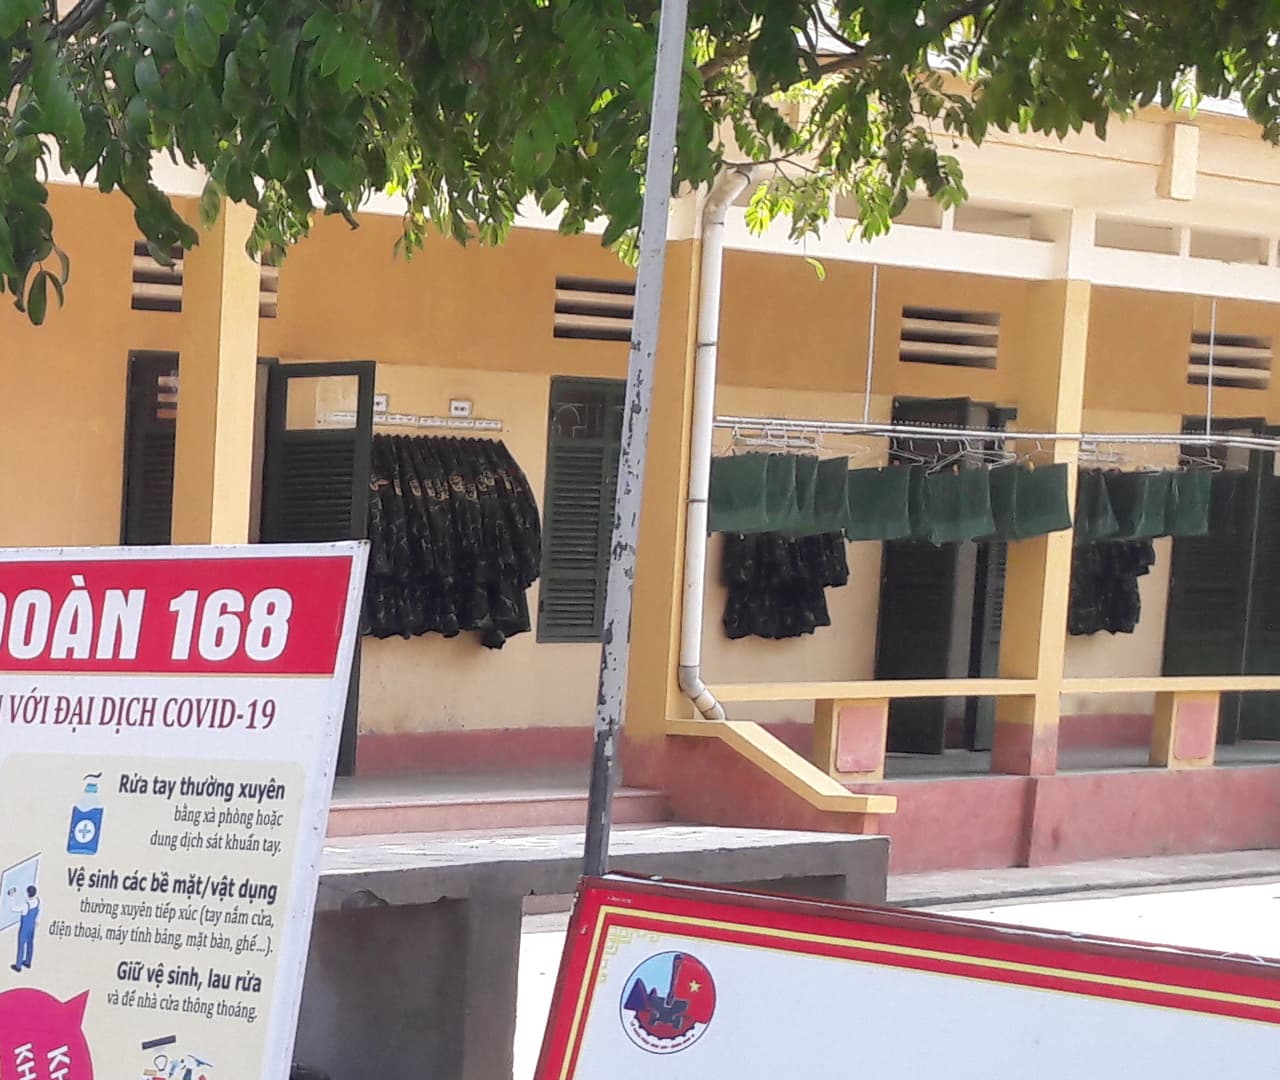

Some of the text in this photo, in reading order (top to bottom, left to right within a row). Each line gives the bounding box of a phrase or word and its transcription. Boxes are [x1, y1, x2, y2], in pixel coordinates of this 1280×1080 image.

[169, 588, 293, 661] 168
[9, 687, 47, 725] VỚI
[53, 696, 92, 737] ĐẠI
[99, 696, 156, 734] DỊCH
[162, 698, 275, 731] COVID-19
[119, 773, 285, 803] Rửa tay thường xuyên
[67, 867, 278, 905] Vệ sinh các bề mặt/vật dụng
[117, 961, 262, 992] Giữ vệ sinh, lau rửa
